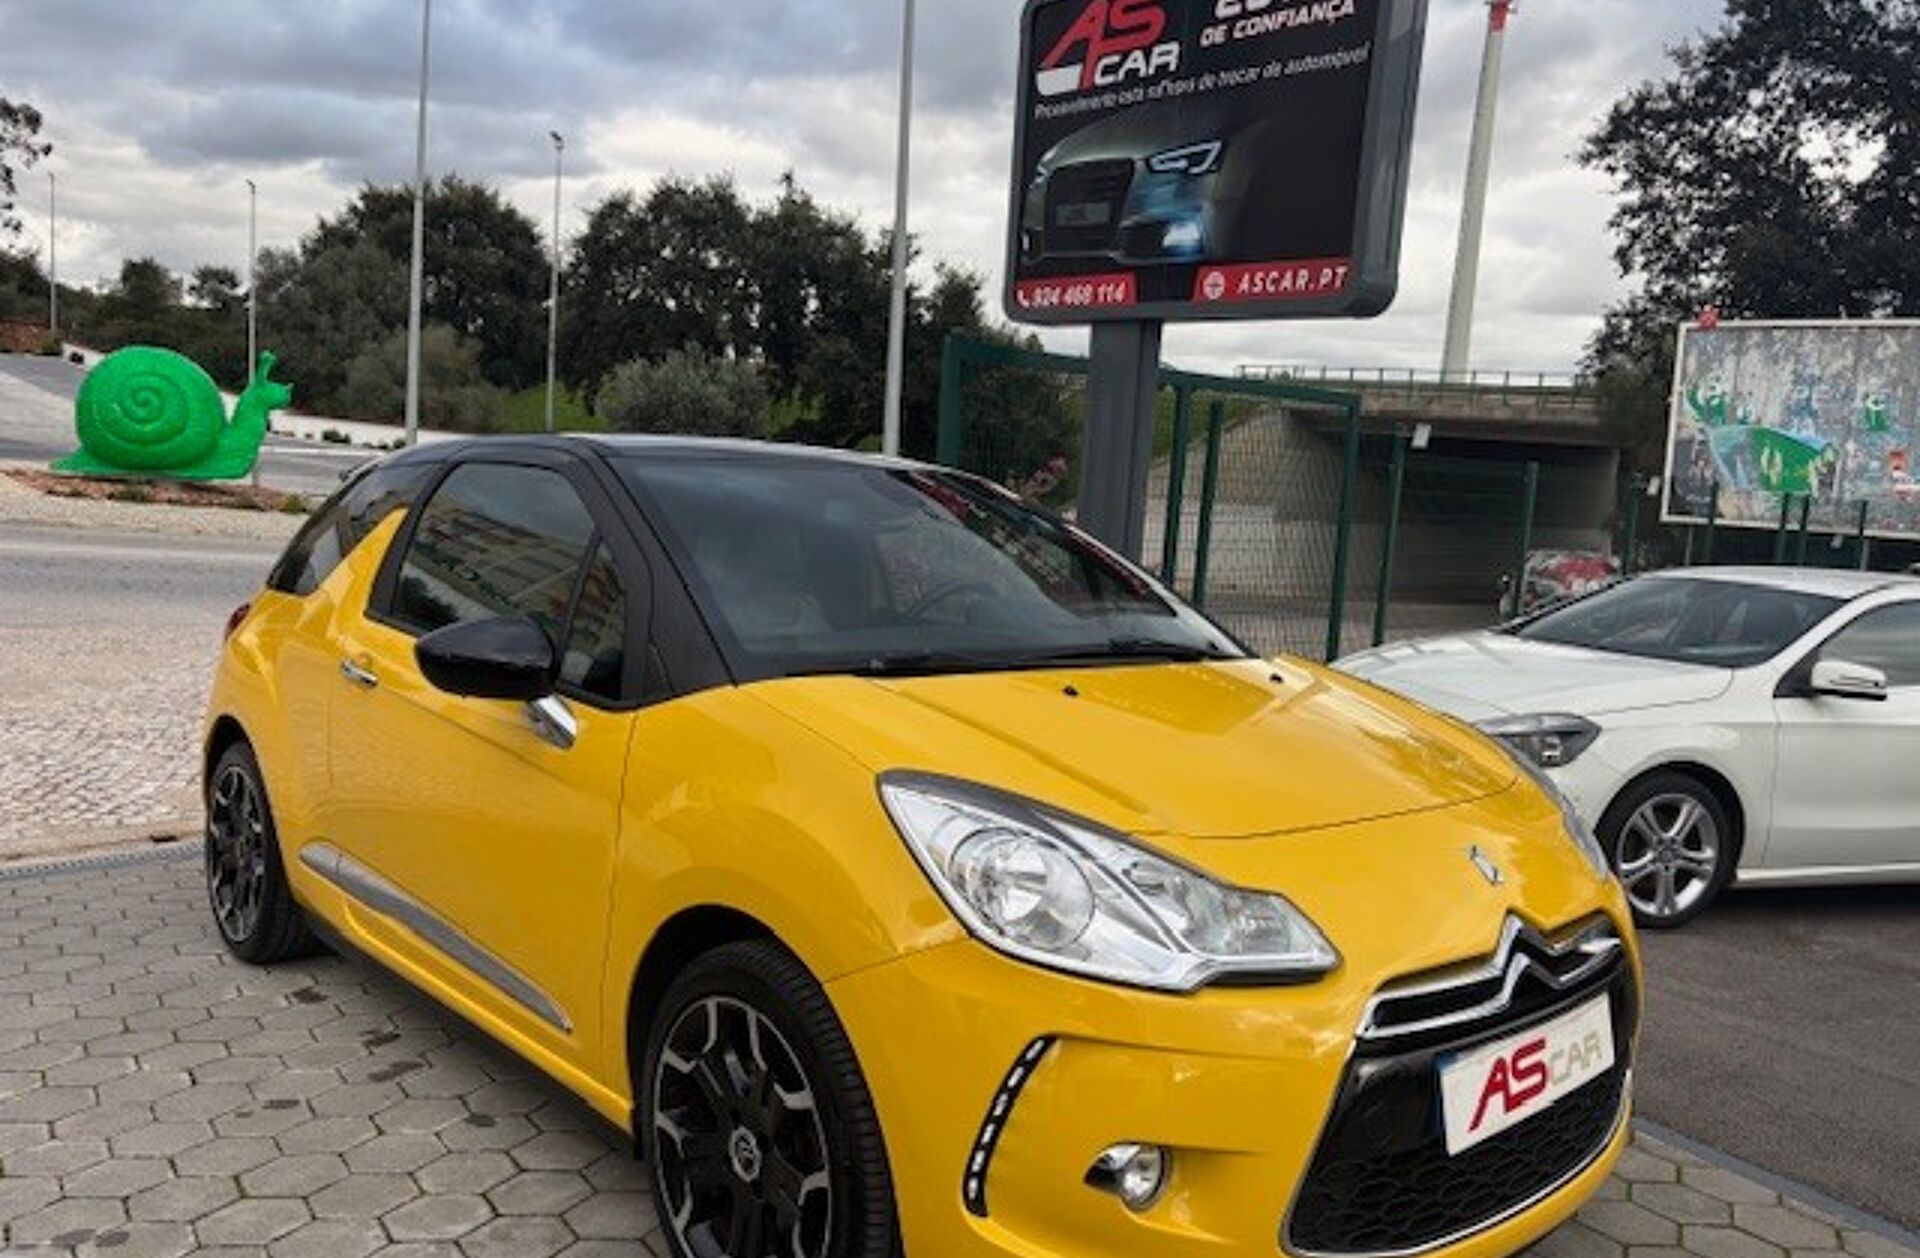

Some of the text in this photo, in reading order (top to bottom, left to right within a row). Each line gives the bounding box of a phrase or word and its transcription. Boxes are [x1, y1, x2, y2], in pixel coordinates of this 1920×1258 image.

[1038, 0, 1165, 90] AS
[1200, 24, 1228, 46] DE
[1232, 0, 1355, 39] CONFIANÇA
[1094, 42, 1180, 85] CAR
[1236, 266, 1347, 294] ASCAR.PT
